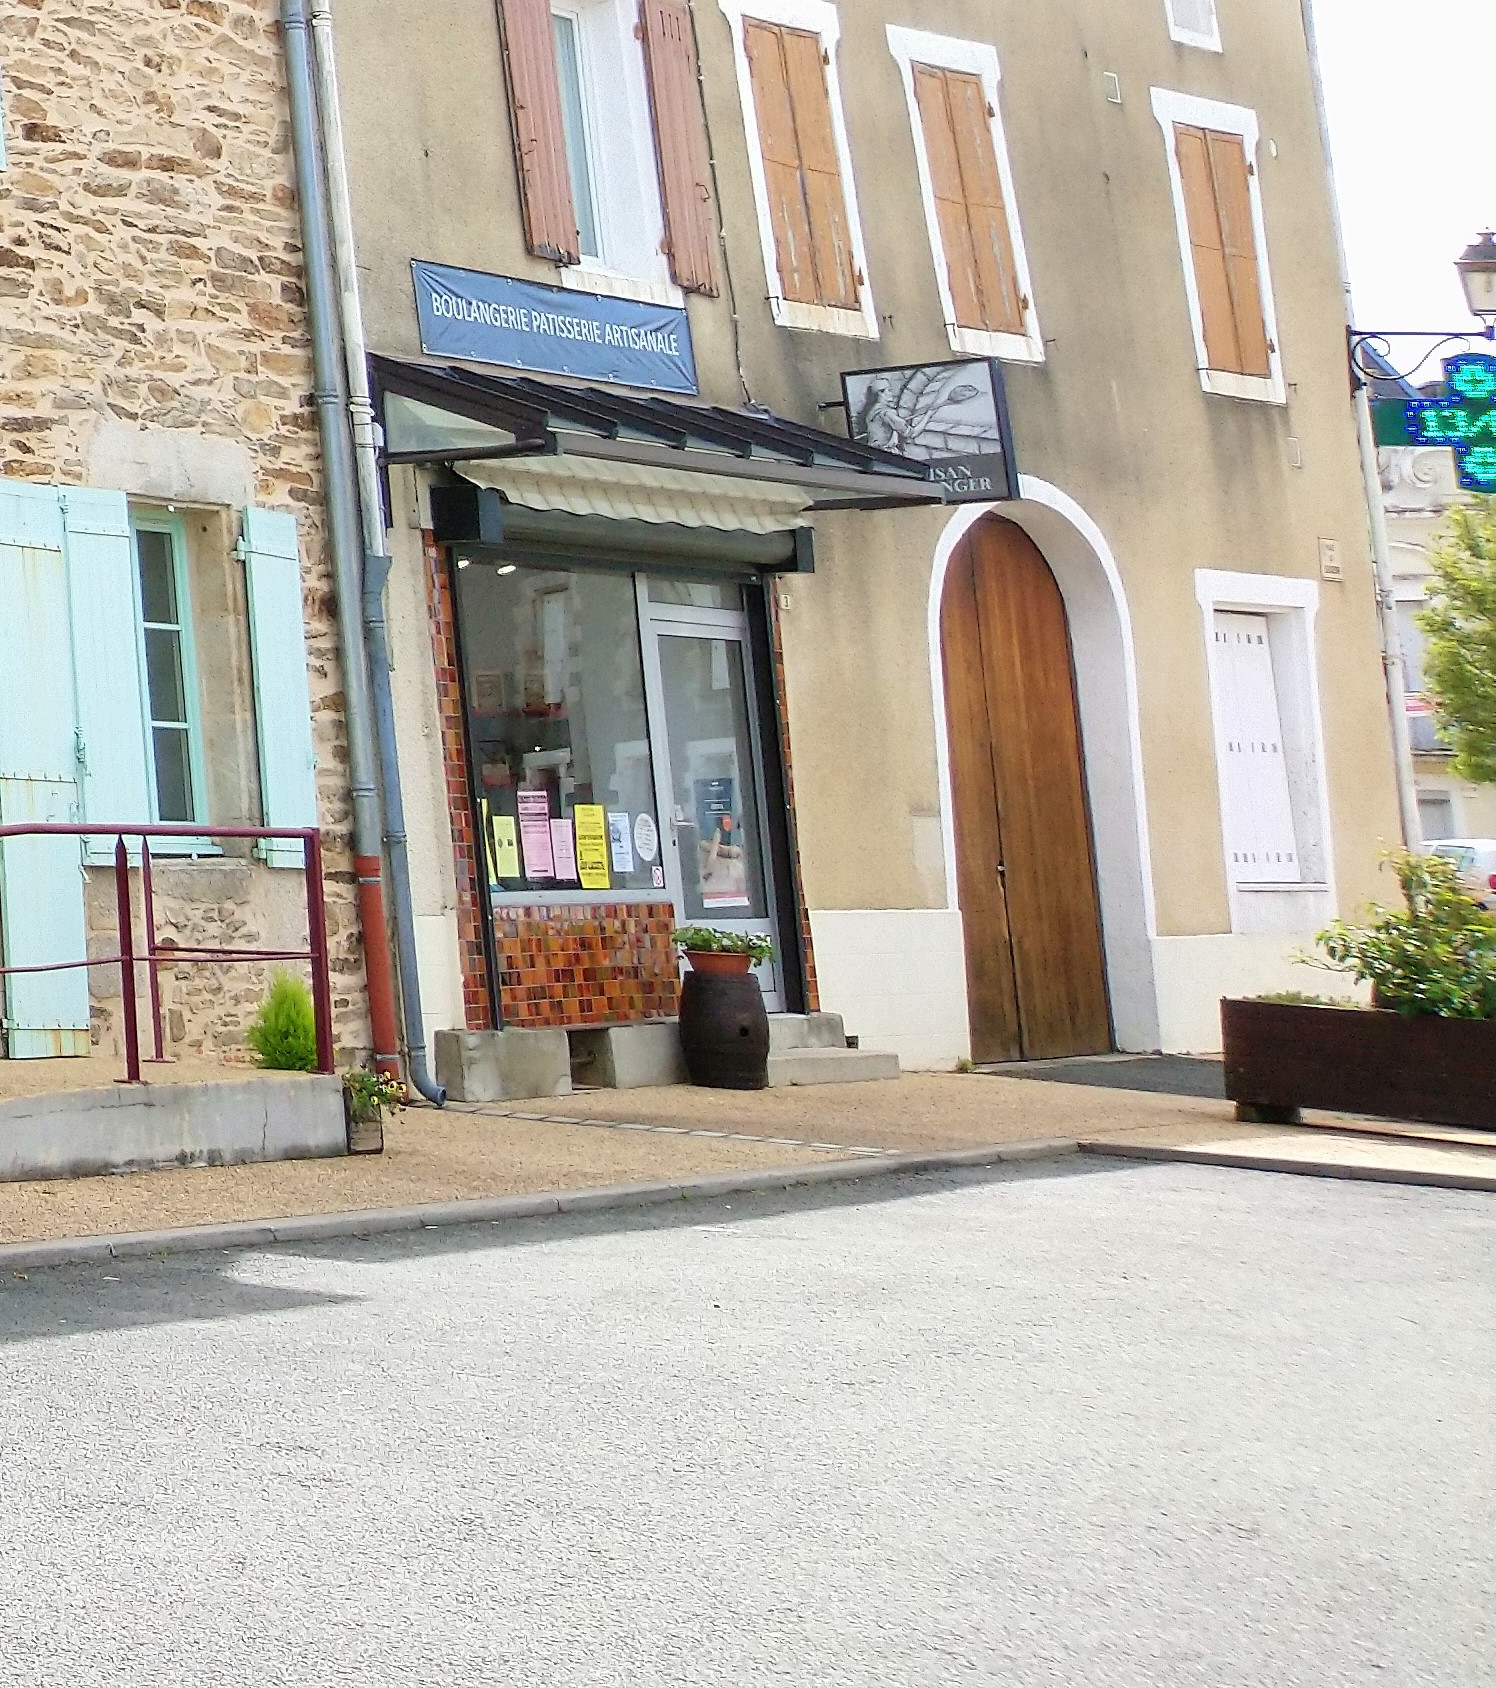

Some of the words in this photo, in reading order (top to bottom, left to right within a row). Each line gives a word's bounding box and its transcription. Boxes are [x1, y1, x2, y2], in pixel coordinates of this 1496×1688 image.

[430, 292, 530, 333] BOULANGERIE
[531, 311, 603, 345] PATISSERIE
[604, 322, 681, 357] ARTISANALE
[927, 465, 972, 482] ISAN
[940, 477, 993, 493] NGER
